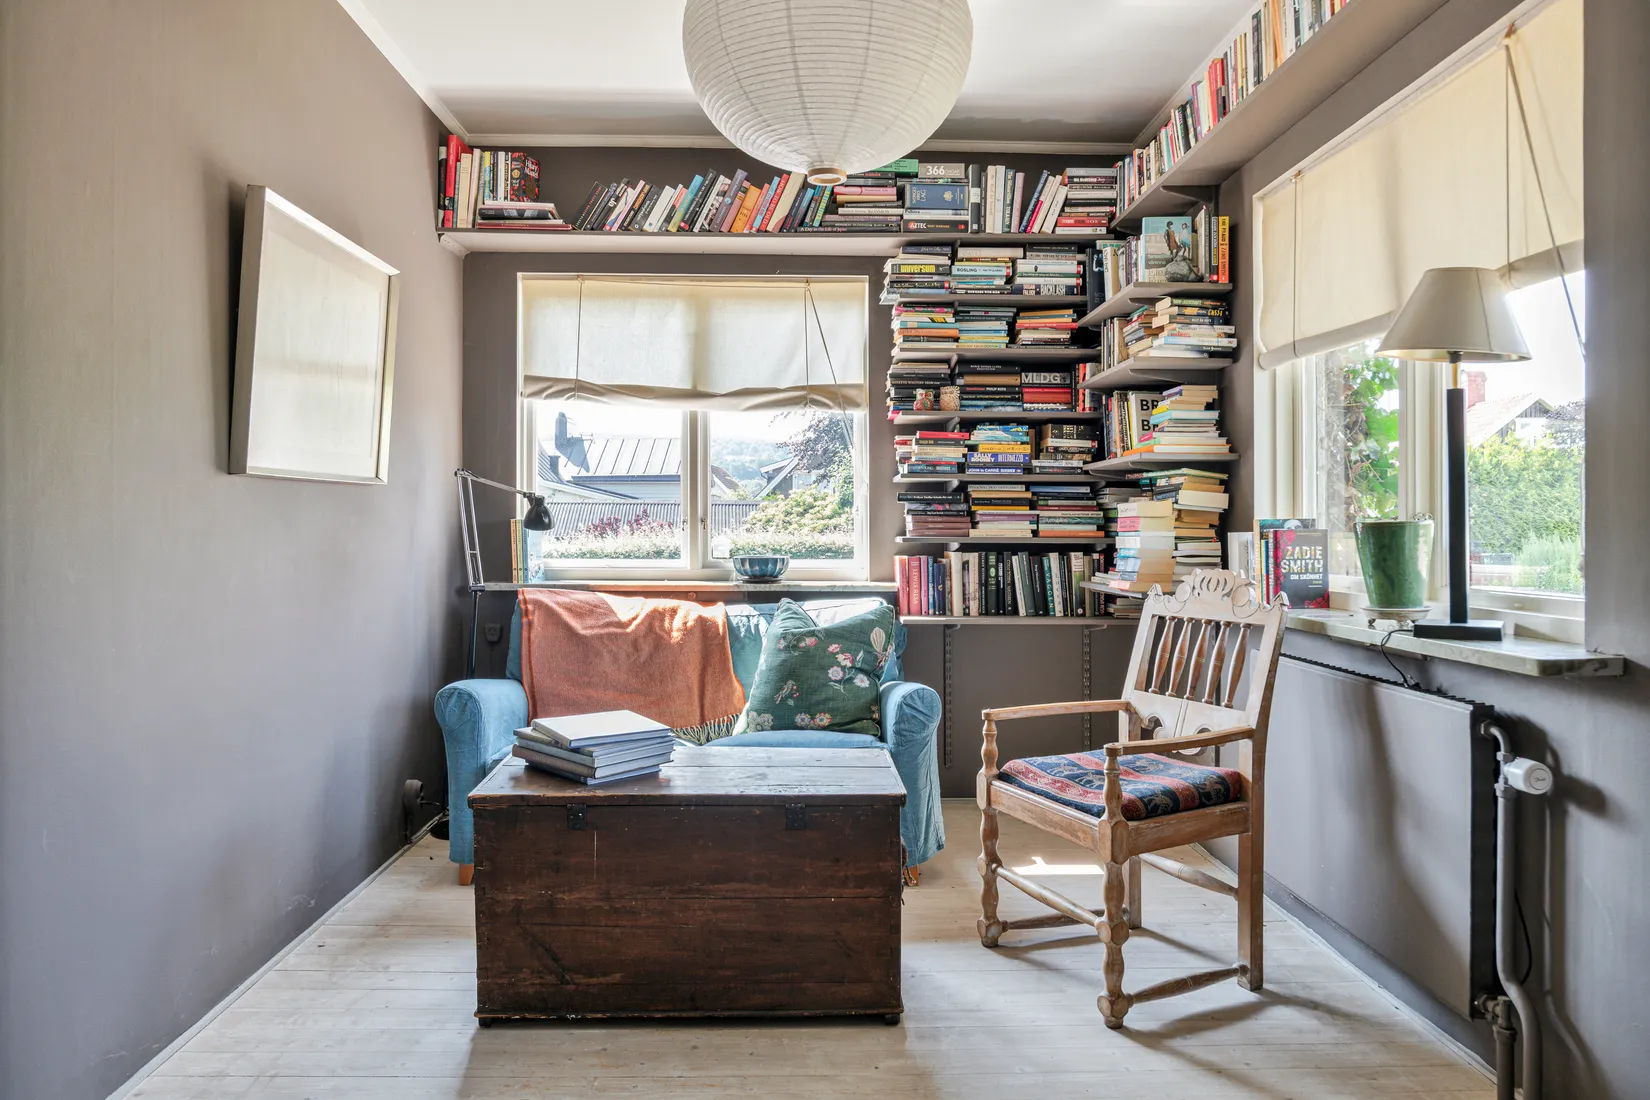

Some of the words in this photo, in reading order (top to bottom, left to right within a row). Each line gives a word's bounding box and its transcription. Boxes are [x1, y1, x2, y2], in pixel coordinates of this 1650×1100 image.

[927, 166, 944, 175] 366
[776, 180, 786, 194] HOW
[608, 197, 618, 208] Ja
[763, 211, 772, 224] OLD
[900, 265, 936, 273] universum
[1041, 284, 1065, 296] BACKLASH
[1286, 546, 1323, 559] ZADIE
[1280, 560, 1323, 573] SMITH
